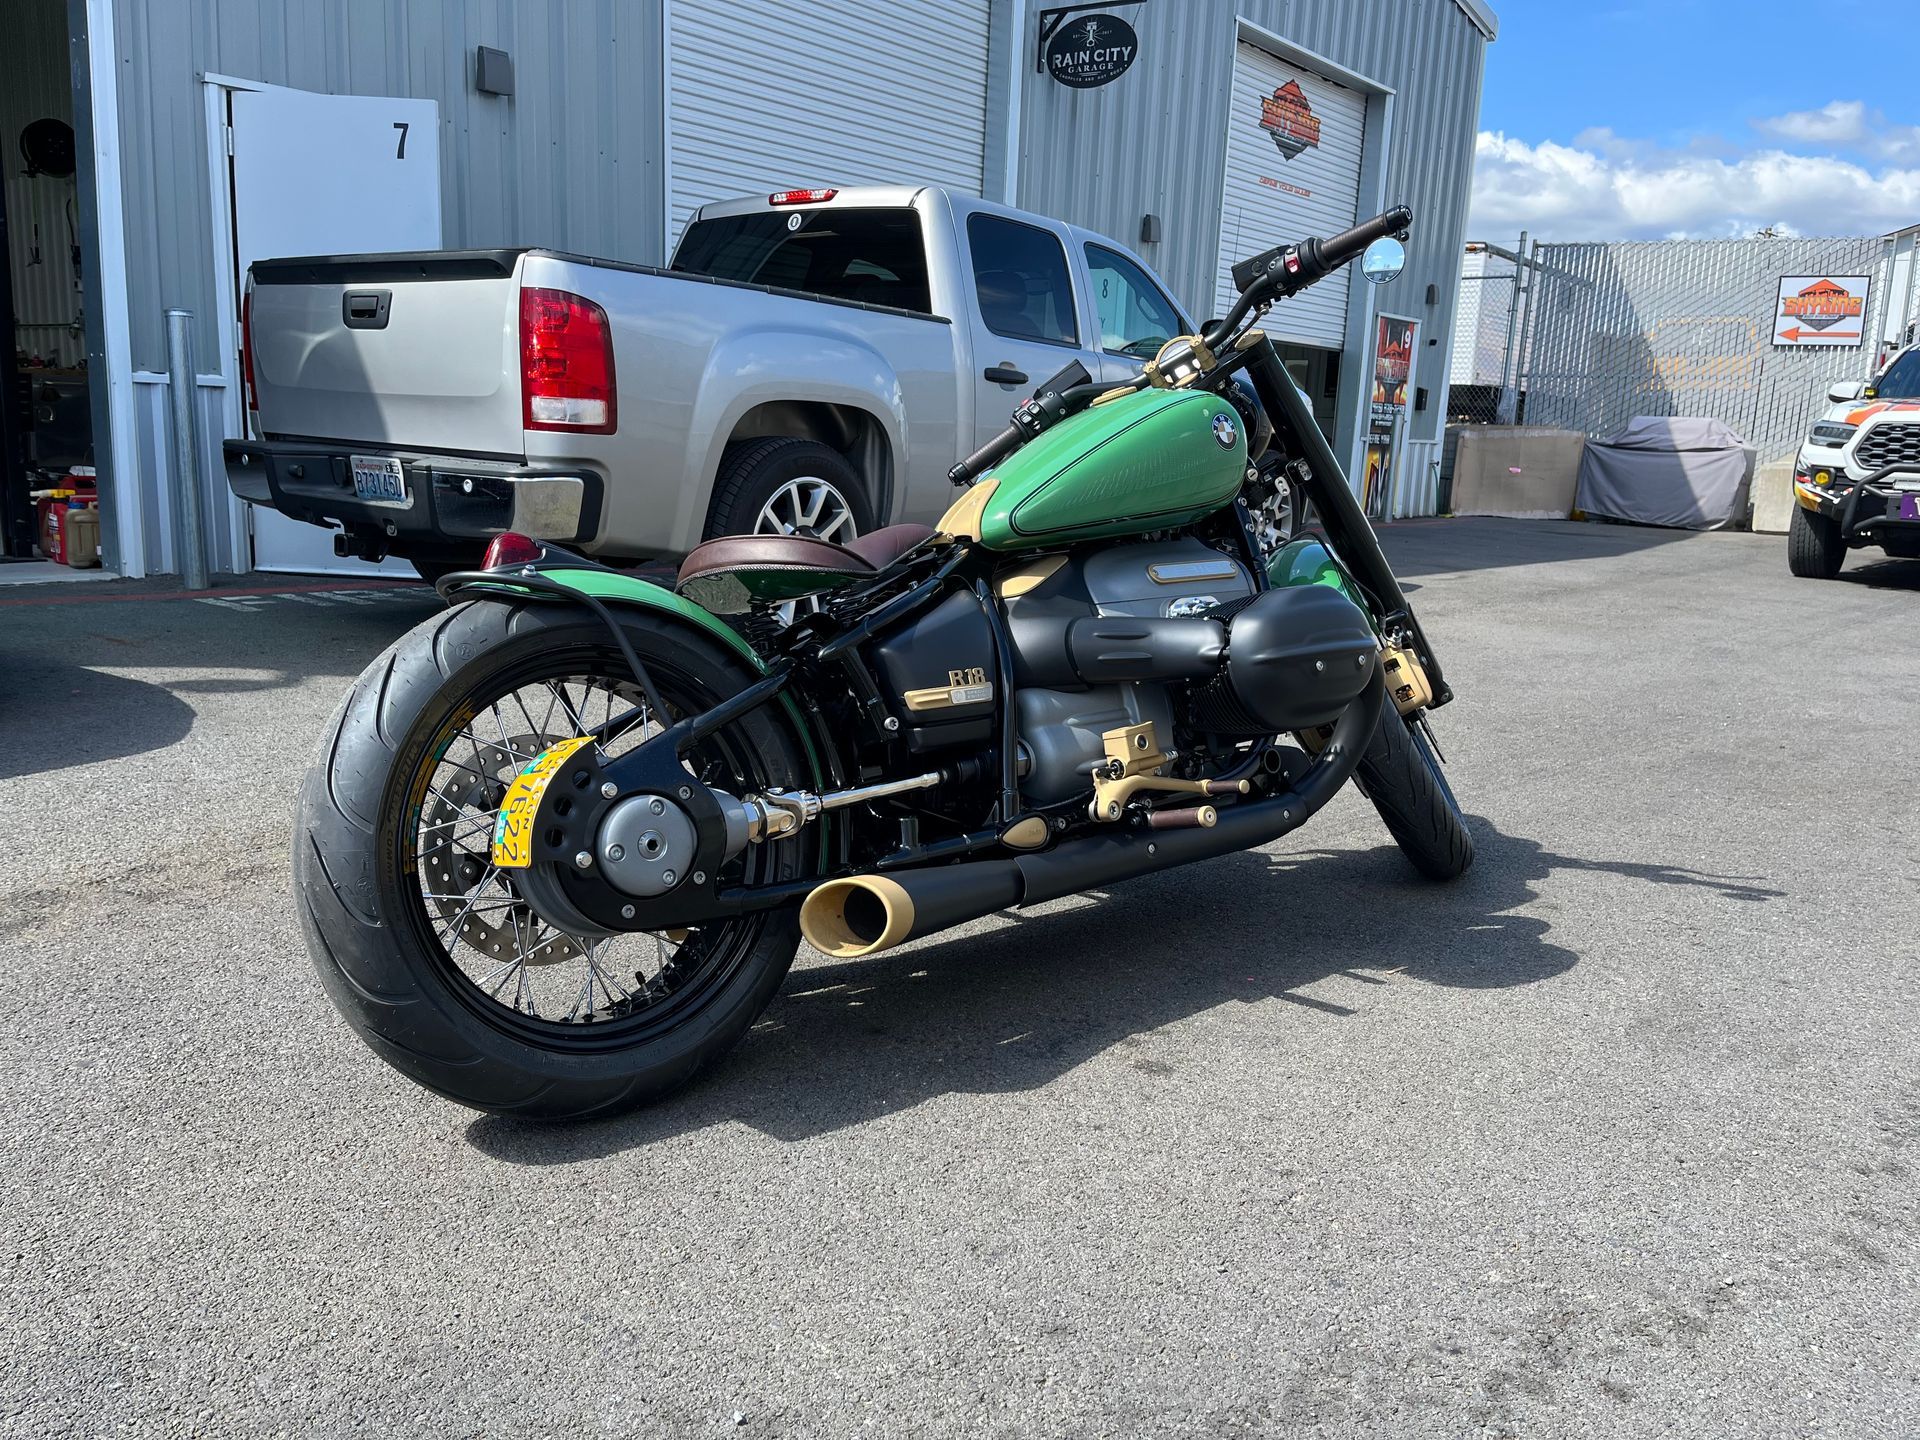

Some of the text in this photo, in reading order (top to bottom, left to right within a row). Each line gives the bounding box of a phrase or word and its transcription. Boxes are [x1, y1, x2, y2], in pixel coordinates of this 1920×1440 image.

[1052, 46, 1132, 69] RAIN CITY
[1067, 62, 1115, 74] GARAGE
[393, 122, 409, 160] 7
[1102, 278, 1109, 298] 8
[1404, 330, 1412, 349] 9
[389, 745, 419, 827] MICHELIN
